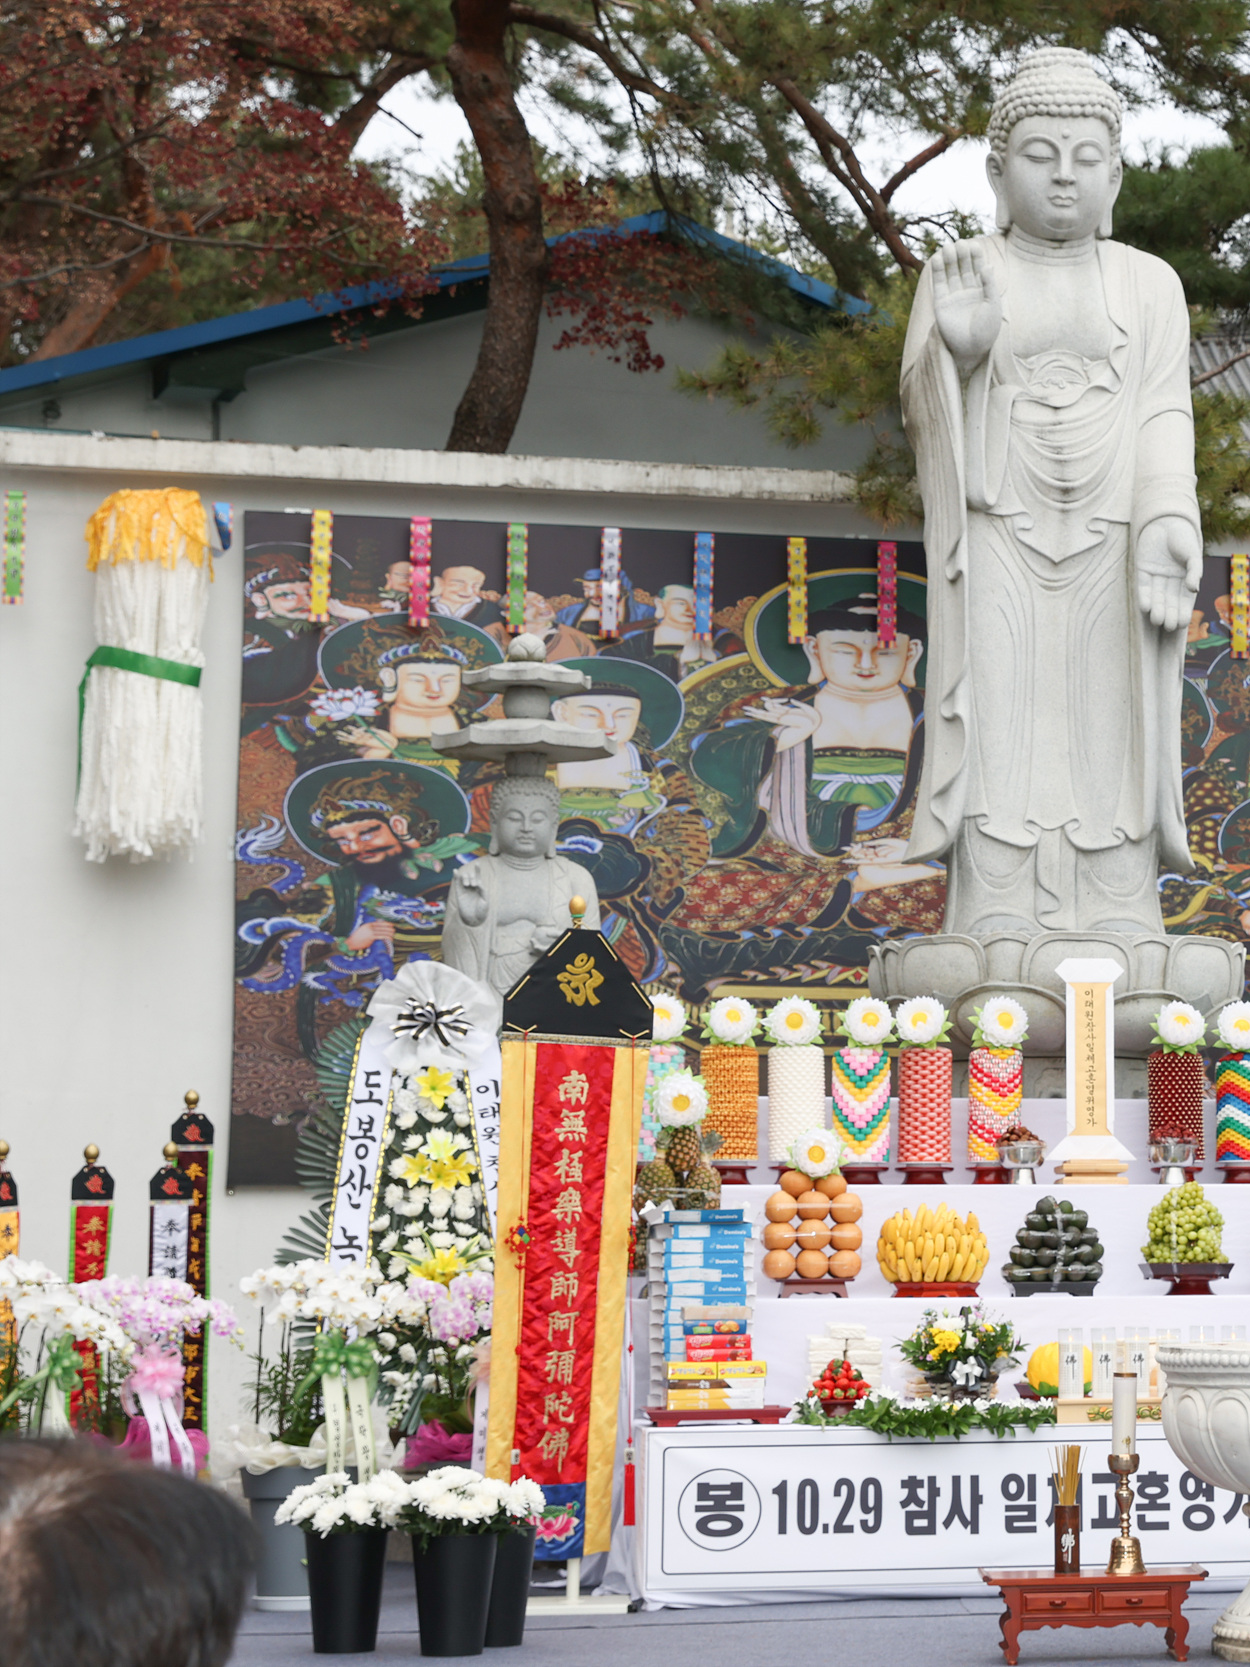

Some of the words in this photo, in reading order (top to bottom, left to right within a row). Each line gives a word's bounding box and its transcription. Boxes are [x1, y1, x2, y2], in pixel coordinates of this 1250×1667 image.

[338, 1070, 384, 1210] 도봉산
[537, 1069, 590, 1473] 南無極樂導師阿彌陀佛
[694, 1481, 745, 1537] 봉
[771, 1477, 883, 1535] 10.29
[900, 1475, 984, 1536] 참사
